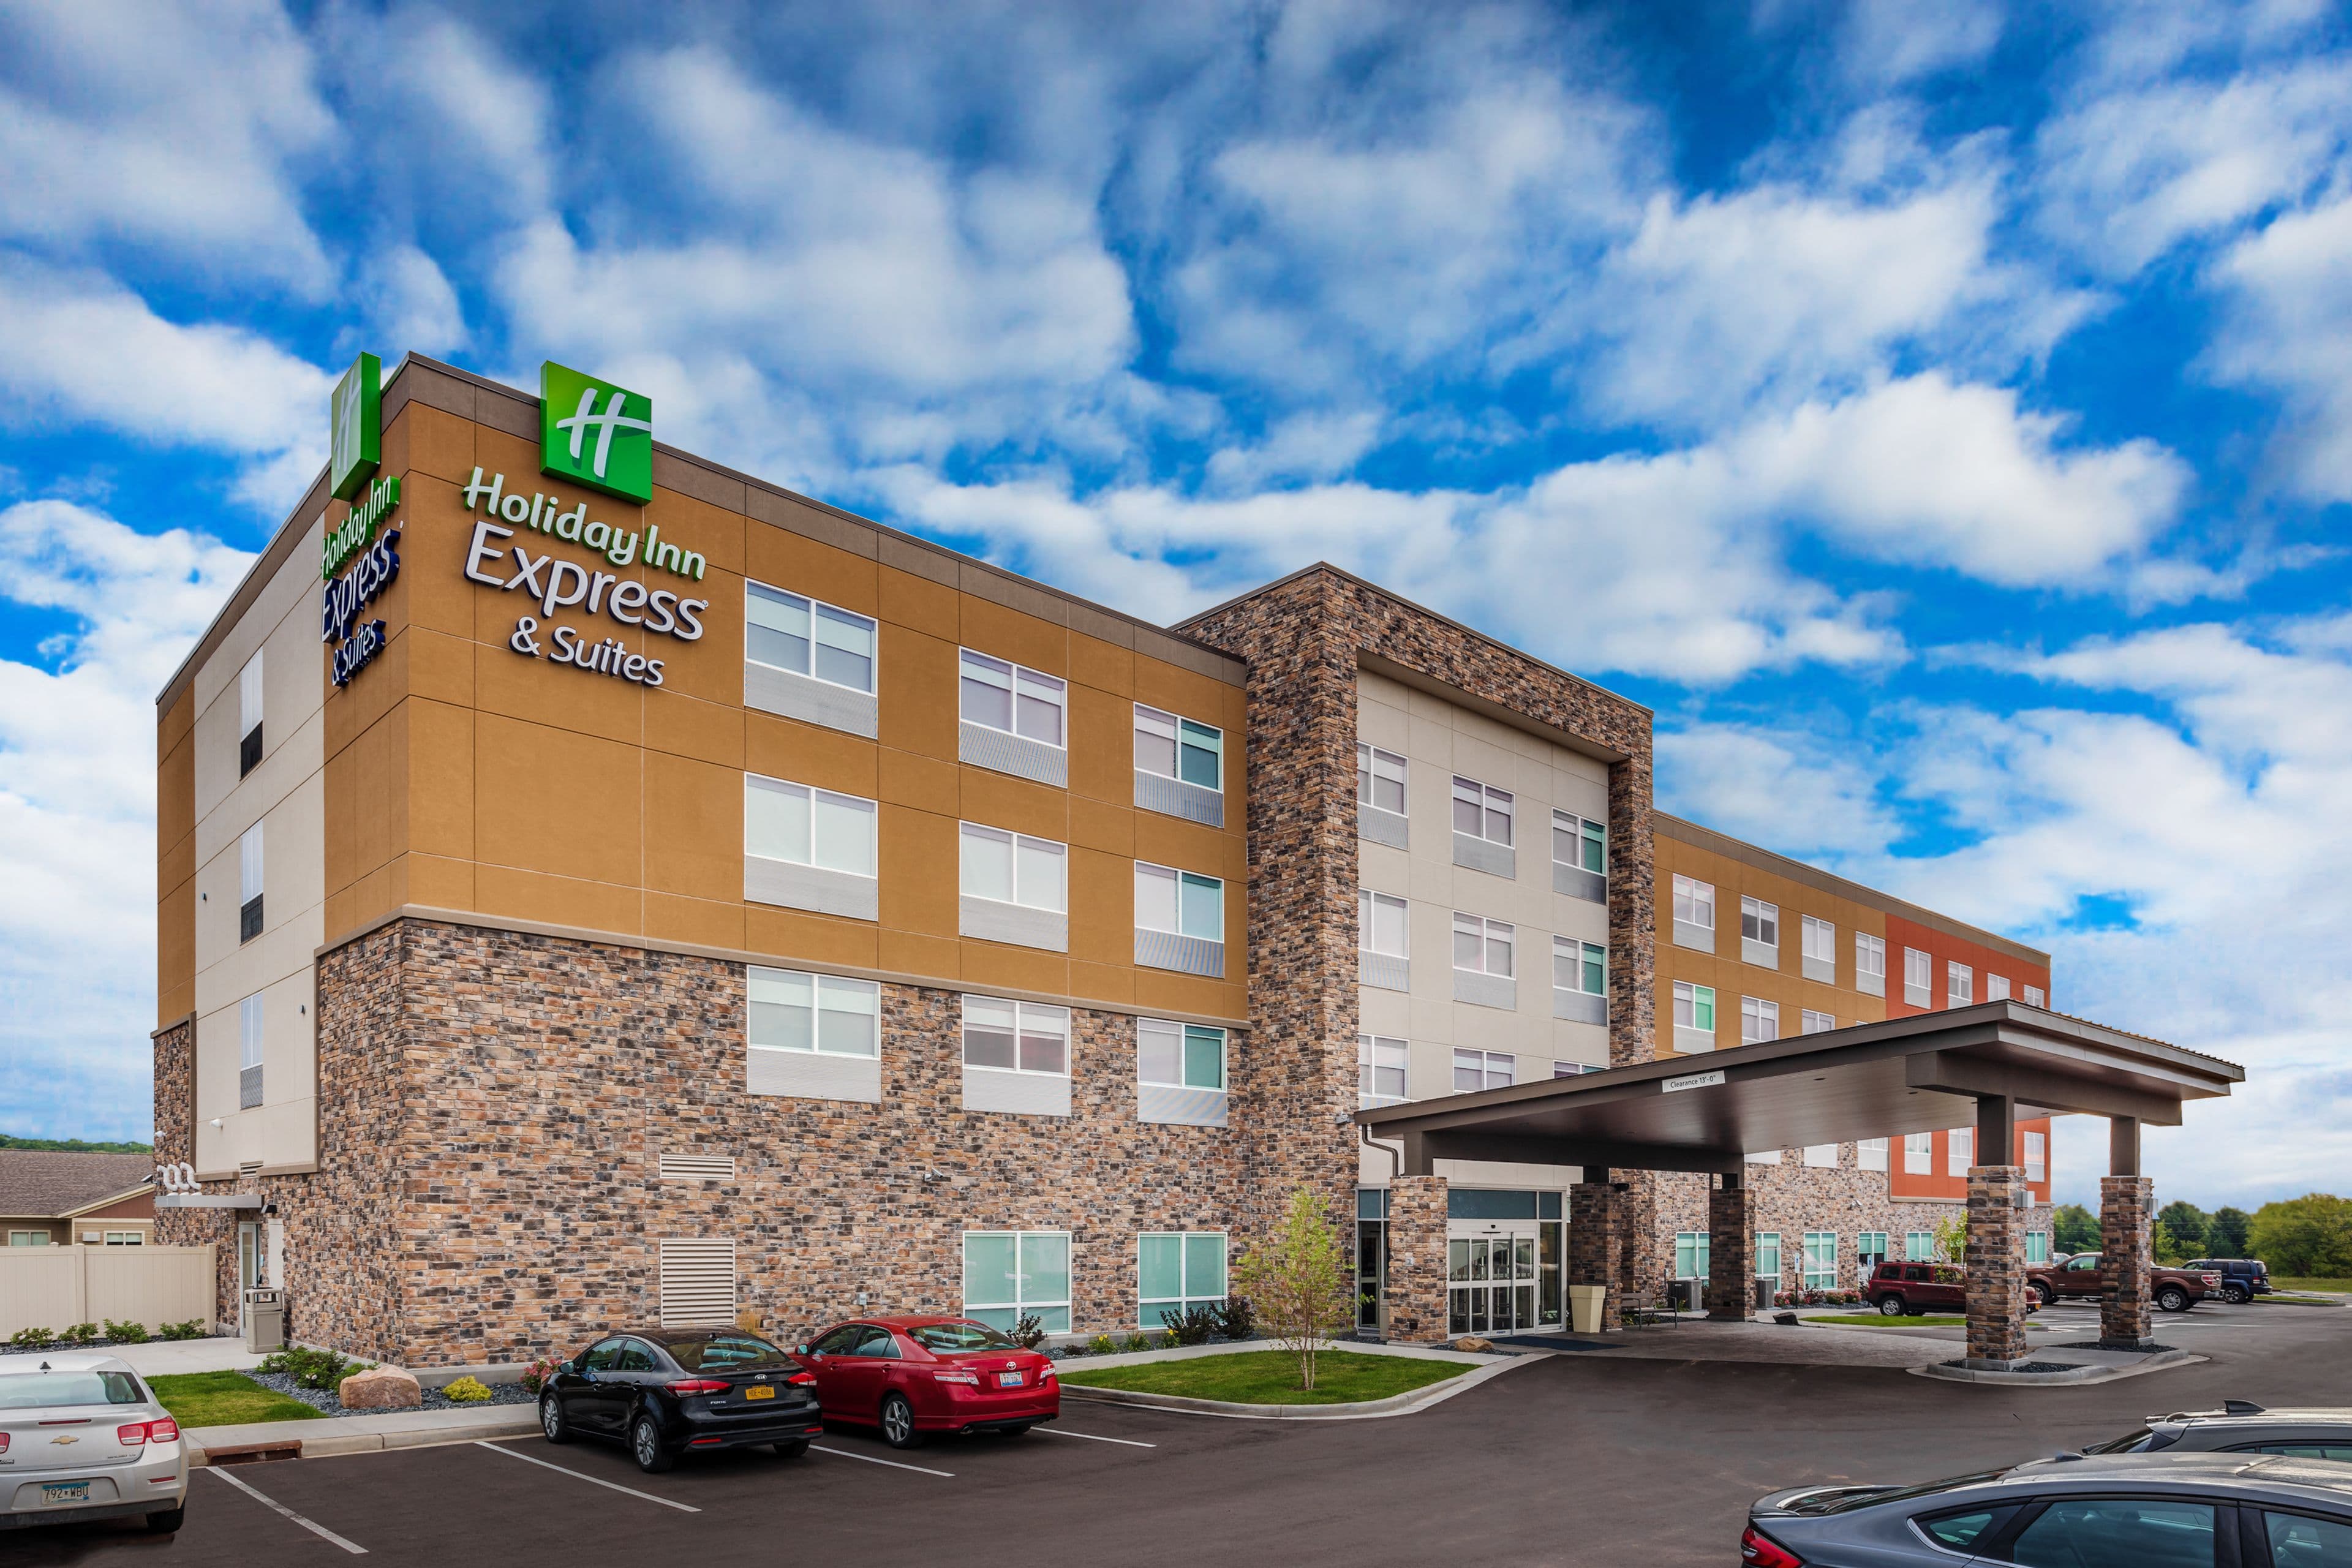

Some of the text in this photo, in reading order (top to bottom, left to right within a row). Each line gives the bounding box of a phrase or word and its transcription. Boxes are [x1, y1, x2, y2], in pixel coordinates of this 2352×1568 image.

[556, 388, 651, 478] H
[322, 475, 395, 578] Holiday Inn
[462, 466, 706, 581] Holiday Inn
[322, 529, 397, 643] Express
[464, 521, 706, 641] Express
[332, 619, 382, 687] & Suites
[510, 617, 665, 686] & Suites
[45, 1489, 63, 1499] 792
